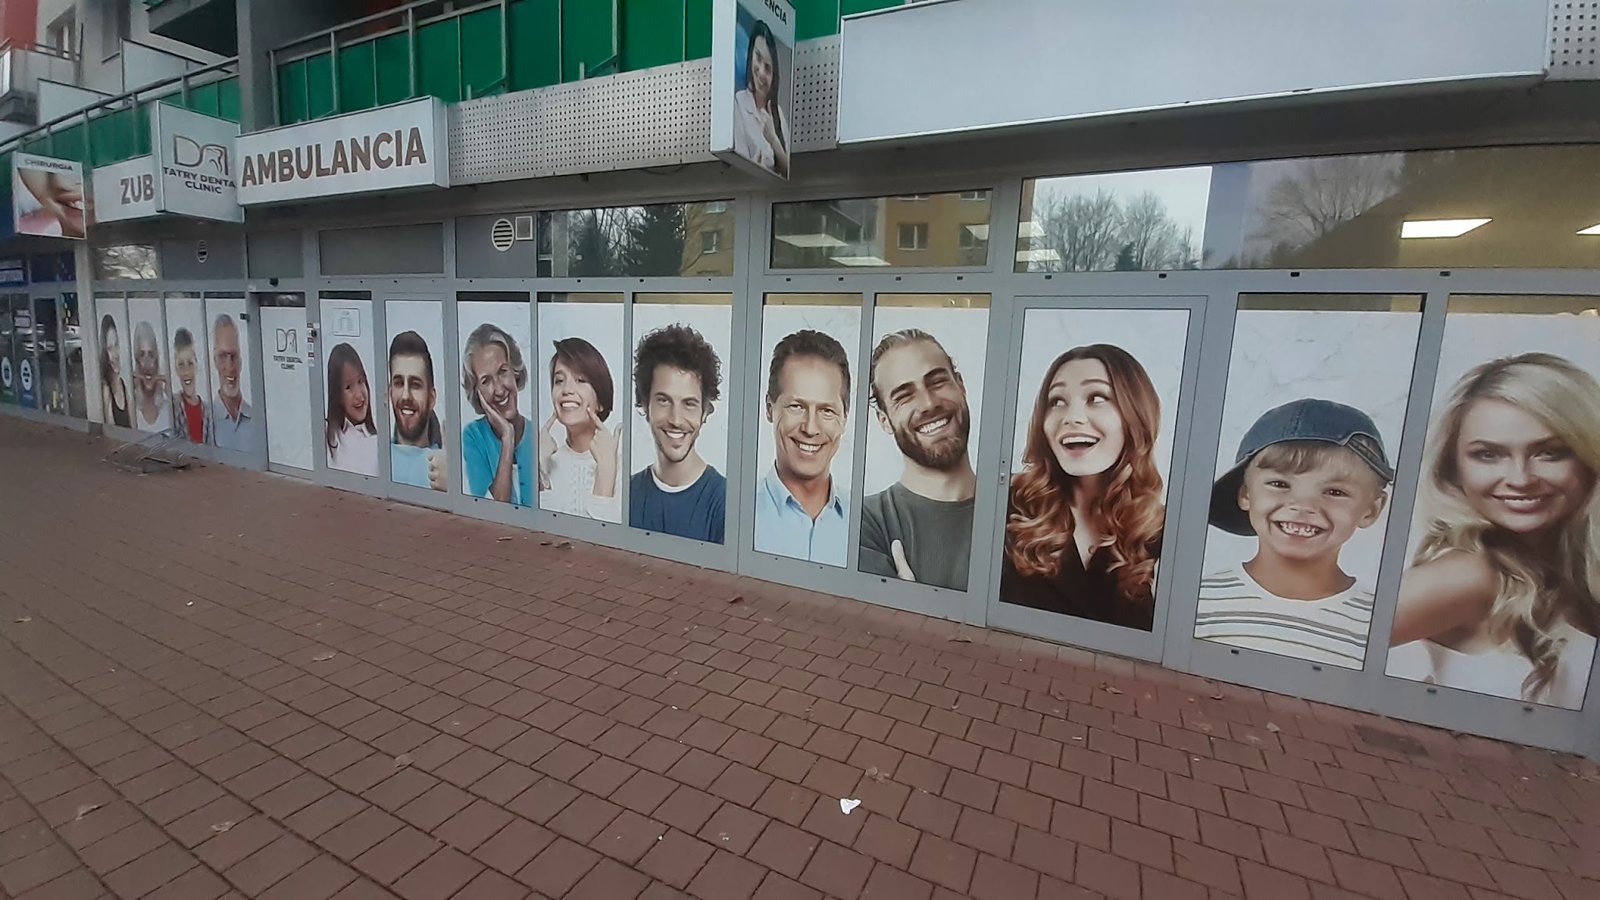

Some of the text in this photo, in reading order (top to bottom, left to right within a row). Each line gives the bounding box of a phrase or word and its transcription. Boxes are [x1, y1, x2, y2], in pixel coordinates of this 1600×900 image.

[242, 127, 427, 187] AMBULANCIA
[163, 166, 198, 181] TATRY
[185, 180, 222, 194] CLINIC
